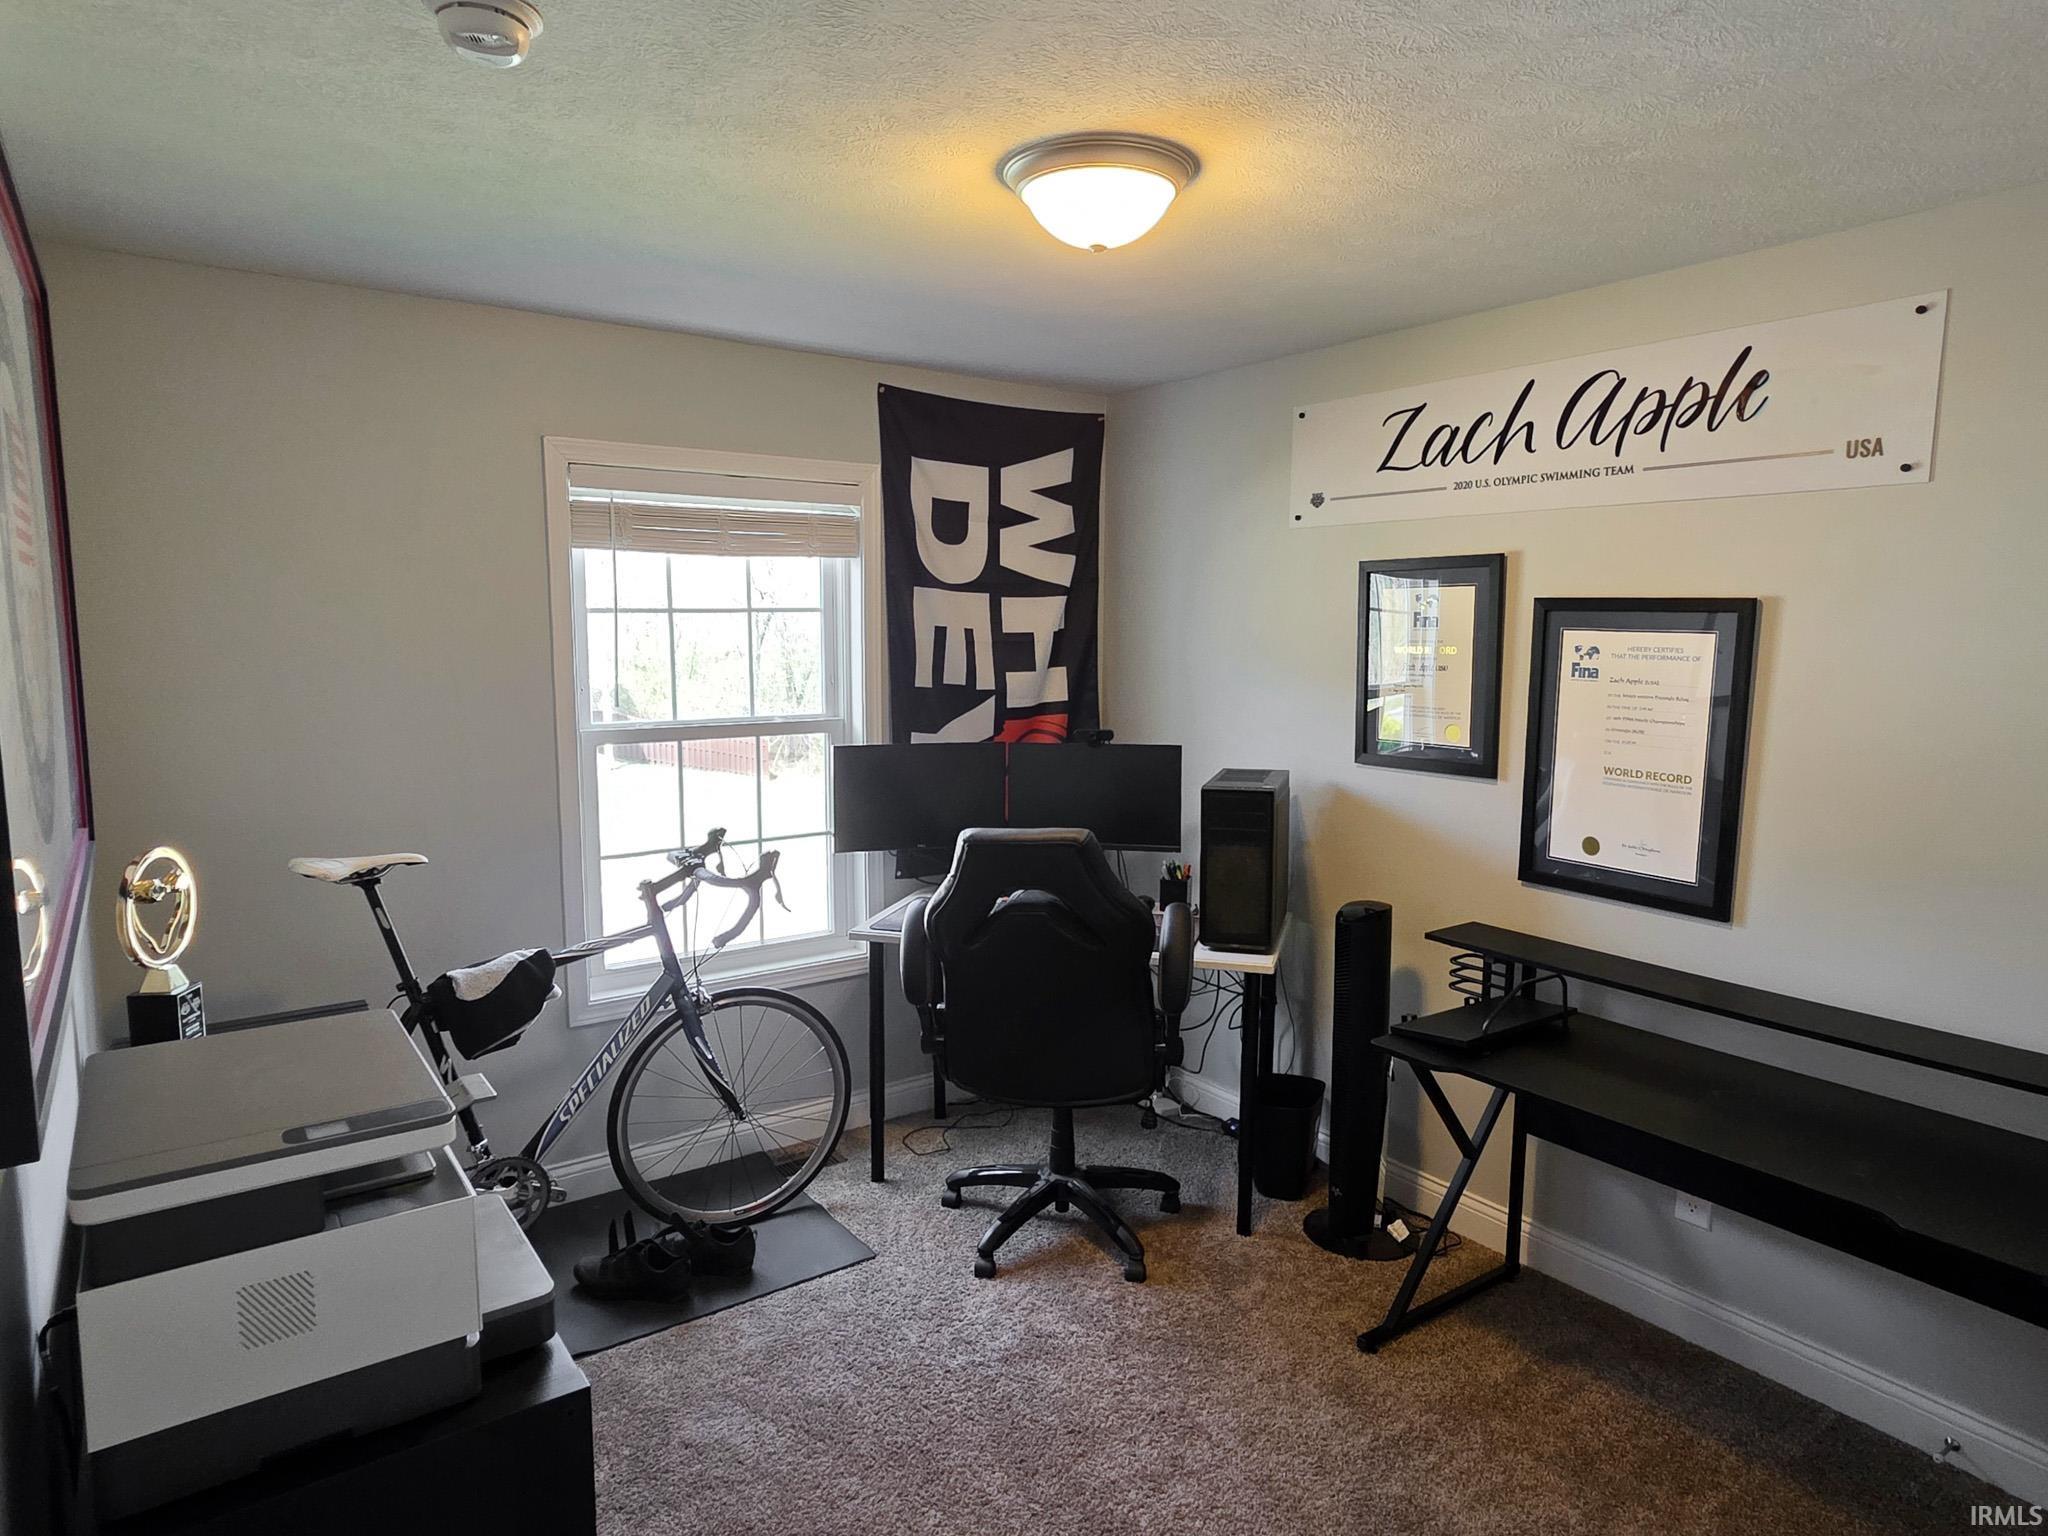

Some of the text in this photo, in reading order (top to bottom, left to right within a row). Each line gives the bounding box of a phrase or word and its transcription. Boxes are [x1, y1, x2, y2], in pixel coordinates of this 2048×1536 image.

[1376, 345, 1770, 473] Zach Apple
[1846, 437, 1884, 459] USA
[1453, 464, 1635, 490] 2020 U.S. OLYMPIC SWIMMING TEAM
[1641, 654, 1690, 662] PERFORMANCE
[1603, 766, 1693, 785] WORLD RECORD
[560, 996, 652, 1122] SPECIALIZED
